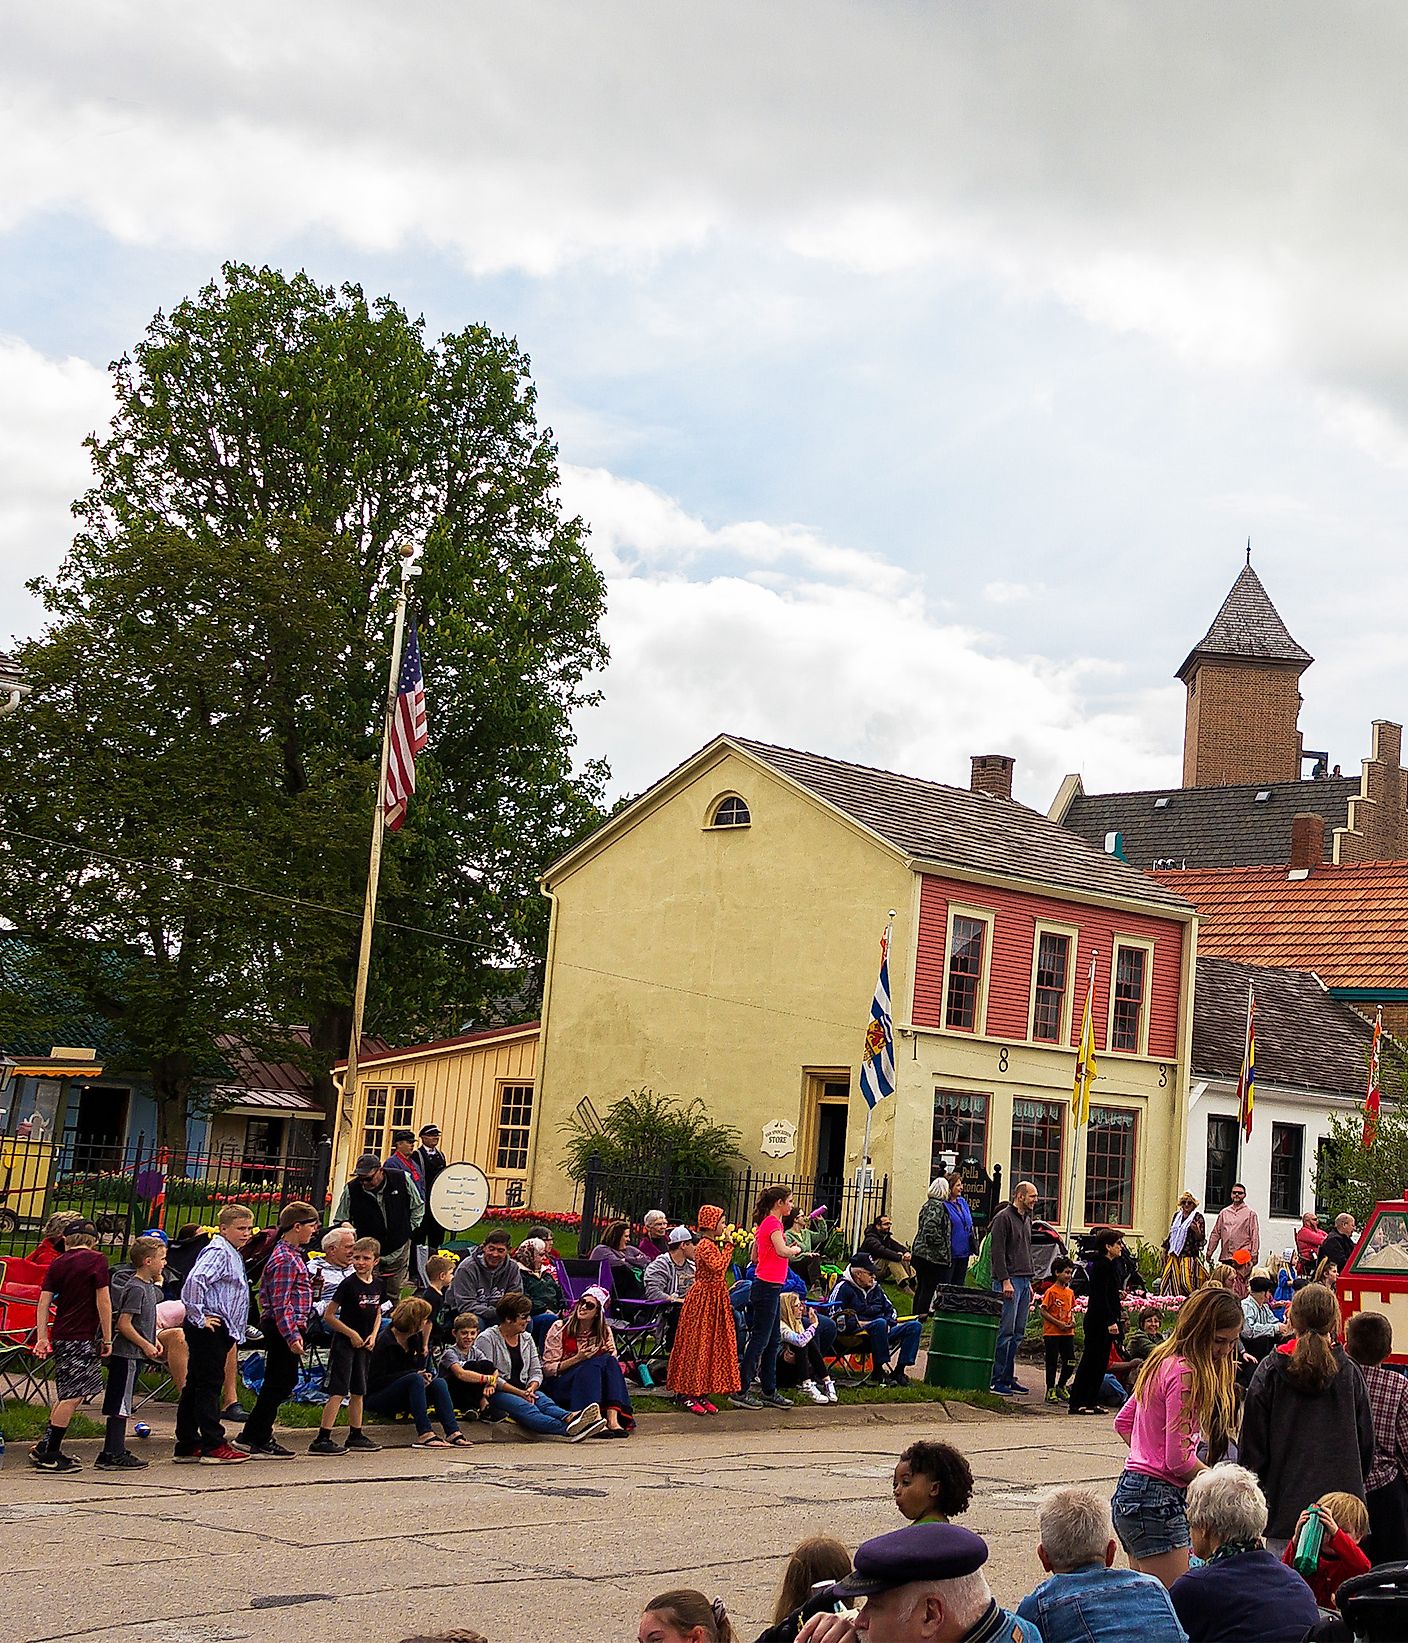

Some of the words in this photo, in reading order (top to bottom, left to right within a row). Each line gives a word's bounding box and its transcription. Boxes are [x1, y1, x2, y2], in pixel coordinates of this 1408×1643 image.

[998, 1047, 1009, 1073] 8
[1158, 1064, 1168, 1088] 3
[768, 1136, 788, 1144] STORE
[962, 1165, 979, 1179] Pella
[963, 1180, 986, 1194] torical
